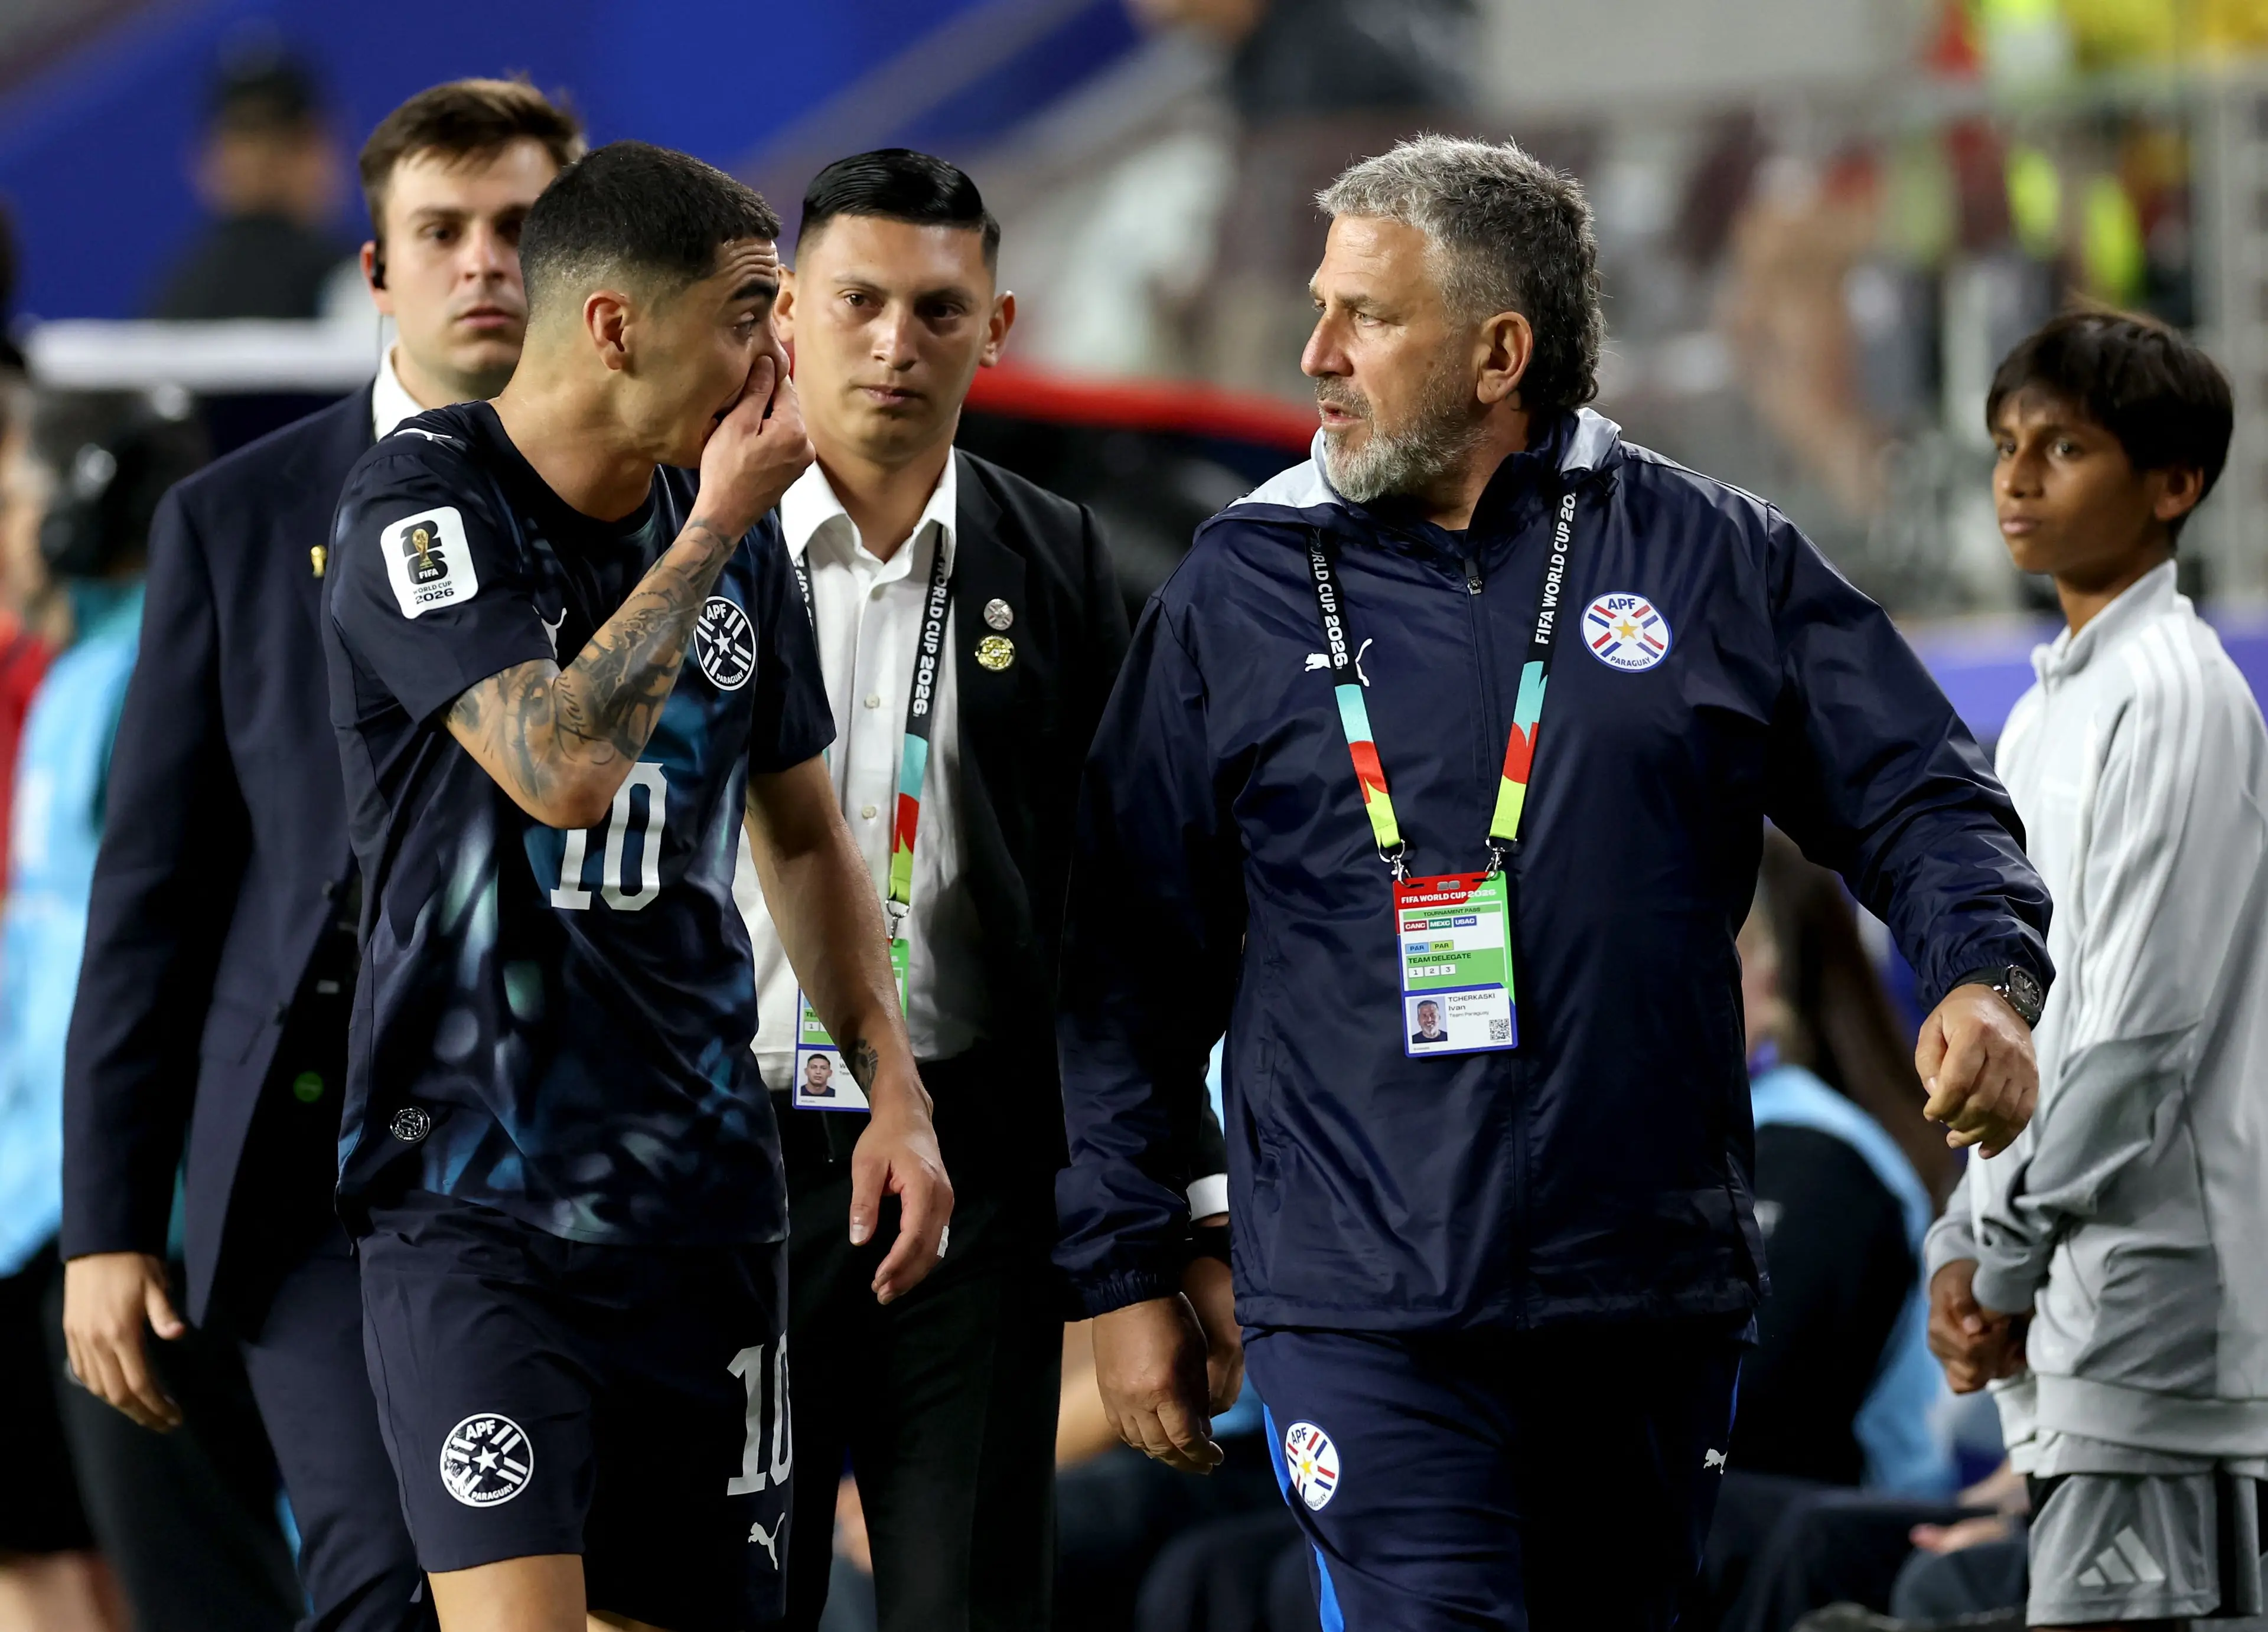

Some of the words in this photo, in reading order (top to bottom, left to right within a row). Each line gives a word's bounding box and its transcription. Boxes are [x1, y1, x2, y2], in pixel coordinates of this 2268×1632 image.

[1560, 492, 1576, 522] 20
[1554, 521, 1570, 552] CUP
[419, 568, 439, 579] FIFA
[1542, 554, 1565, 608] WORLD
[413, 584, 437, 595] WORLD
[438, 580, 452, 589] CUP
[415, 588, 455, 605] 2026
[1318, 583, 1337, 613] CUP
[1608, 598, 1635, 610] APF
[706, 603, 726, 620] APF
[1535, 611, 1555, 644] FIFA
[923, 621, 941, 654] CUP
[1324, 615, 1348, 667] 2026
[1610, 656, 1651, 667] PARAGUAY
[716, 670, 744, 684] PARAGUAY
[913, 655, 935, 715] 2026
[1402, 895, 1419, 904] FIFA
[1419, 893, 1450, 902] WORLD
[1450, 891, 1467, 899] CUP
[1468, 889, 1497, 898] 2026
[1423, 908, 1464, 916] TOURNAMENT
[1432, 953, 1471, 962] DELEGATE
[1448, 993, 1495, 1002] TCHERKASKI
[726, 1329, 792, 1496] 10
[465, 1419, 496, 1440] APF
[1291, 1427, 1307, 1445] APF
[471, 1483, 514, 1501] PARAGUAY
